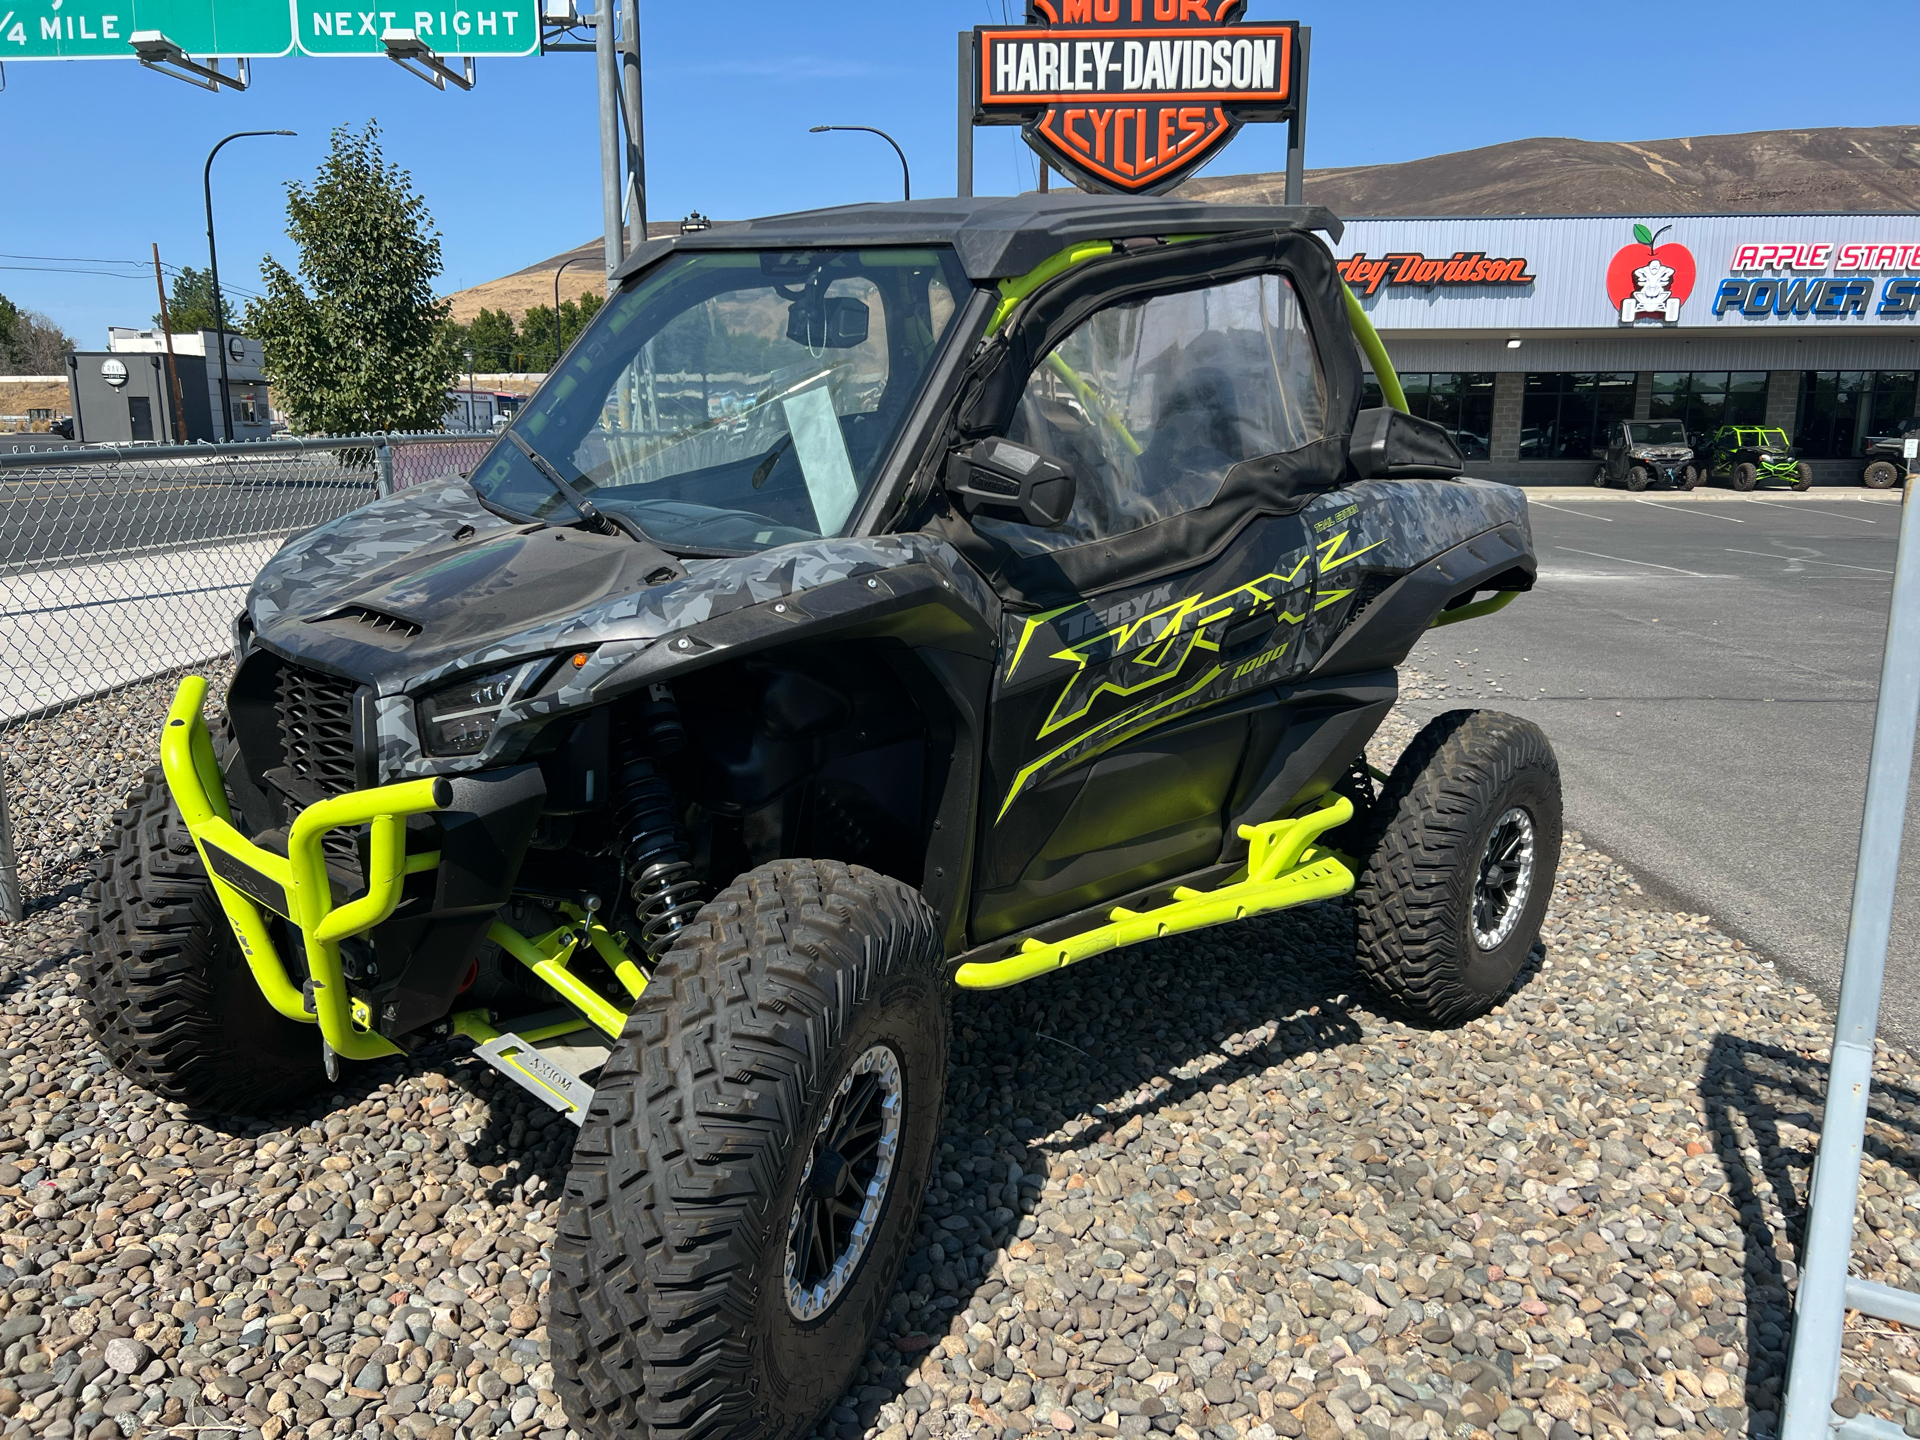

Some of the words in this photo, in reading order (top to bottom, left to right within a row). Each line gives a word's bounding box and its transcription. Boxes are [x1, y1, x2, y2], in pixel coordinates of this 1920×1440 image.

[40, 15, 120, 40] MILE
[313, 12, 396, 36] NEXT
[415, 11, 518, 36] RIGHT
[996, 40, 1276, 92] HARLEY-DAVIDSON
[1063, 107, 1206, 176] CYCLES
[1733, 243, 1833, 270] APPLE
[1715, 279, 1874, 313] POWER
[101, 364, 125, 374] CRAVE
[1313, 516, 1336, 534] TRAIL
[1060, 583, 1173, 642] TERYX
[1232, 642, 1289, 679] 1000
[529, 1057, 573, 1091] AXIOM
